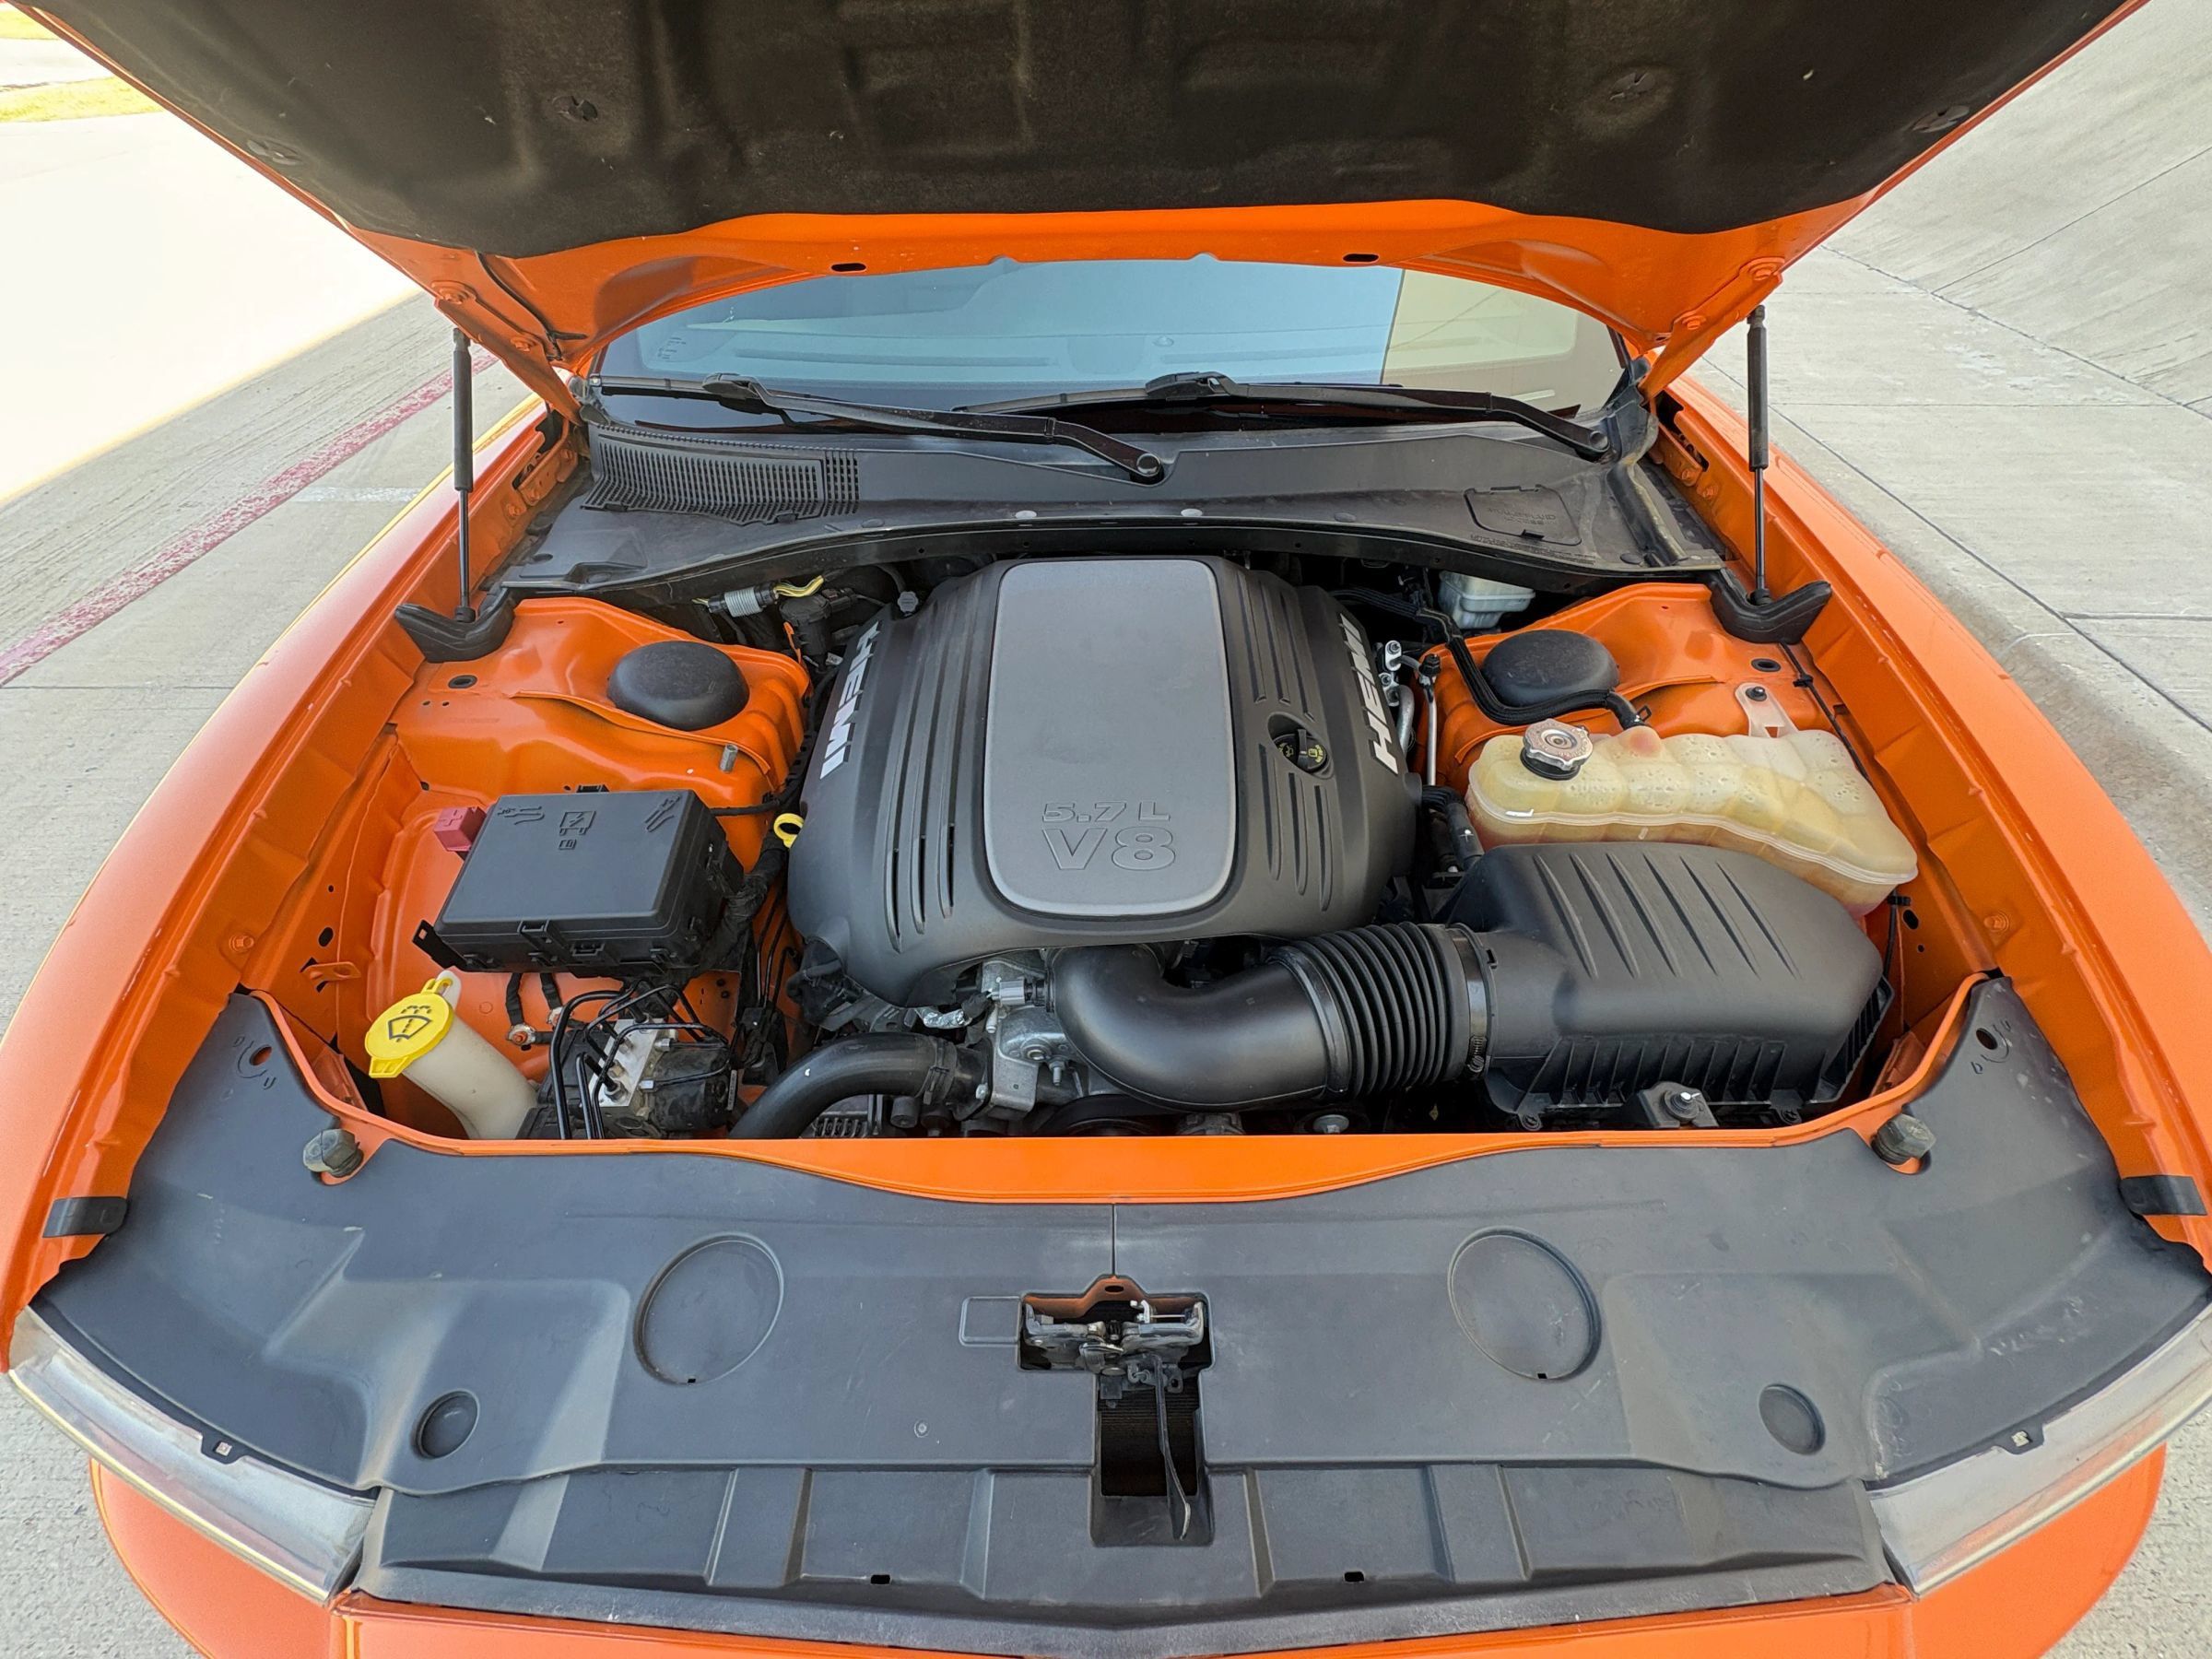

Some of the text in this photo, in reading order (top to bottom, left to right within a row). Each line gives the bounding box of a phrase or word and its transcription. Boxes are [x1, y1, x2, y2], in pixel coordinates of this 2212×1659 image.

[811, 621, 880, 781] HEMI
[1339, 613, 1399, 775] HEMI
[1041, 826, 1176, 871] V8
